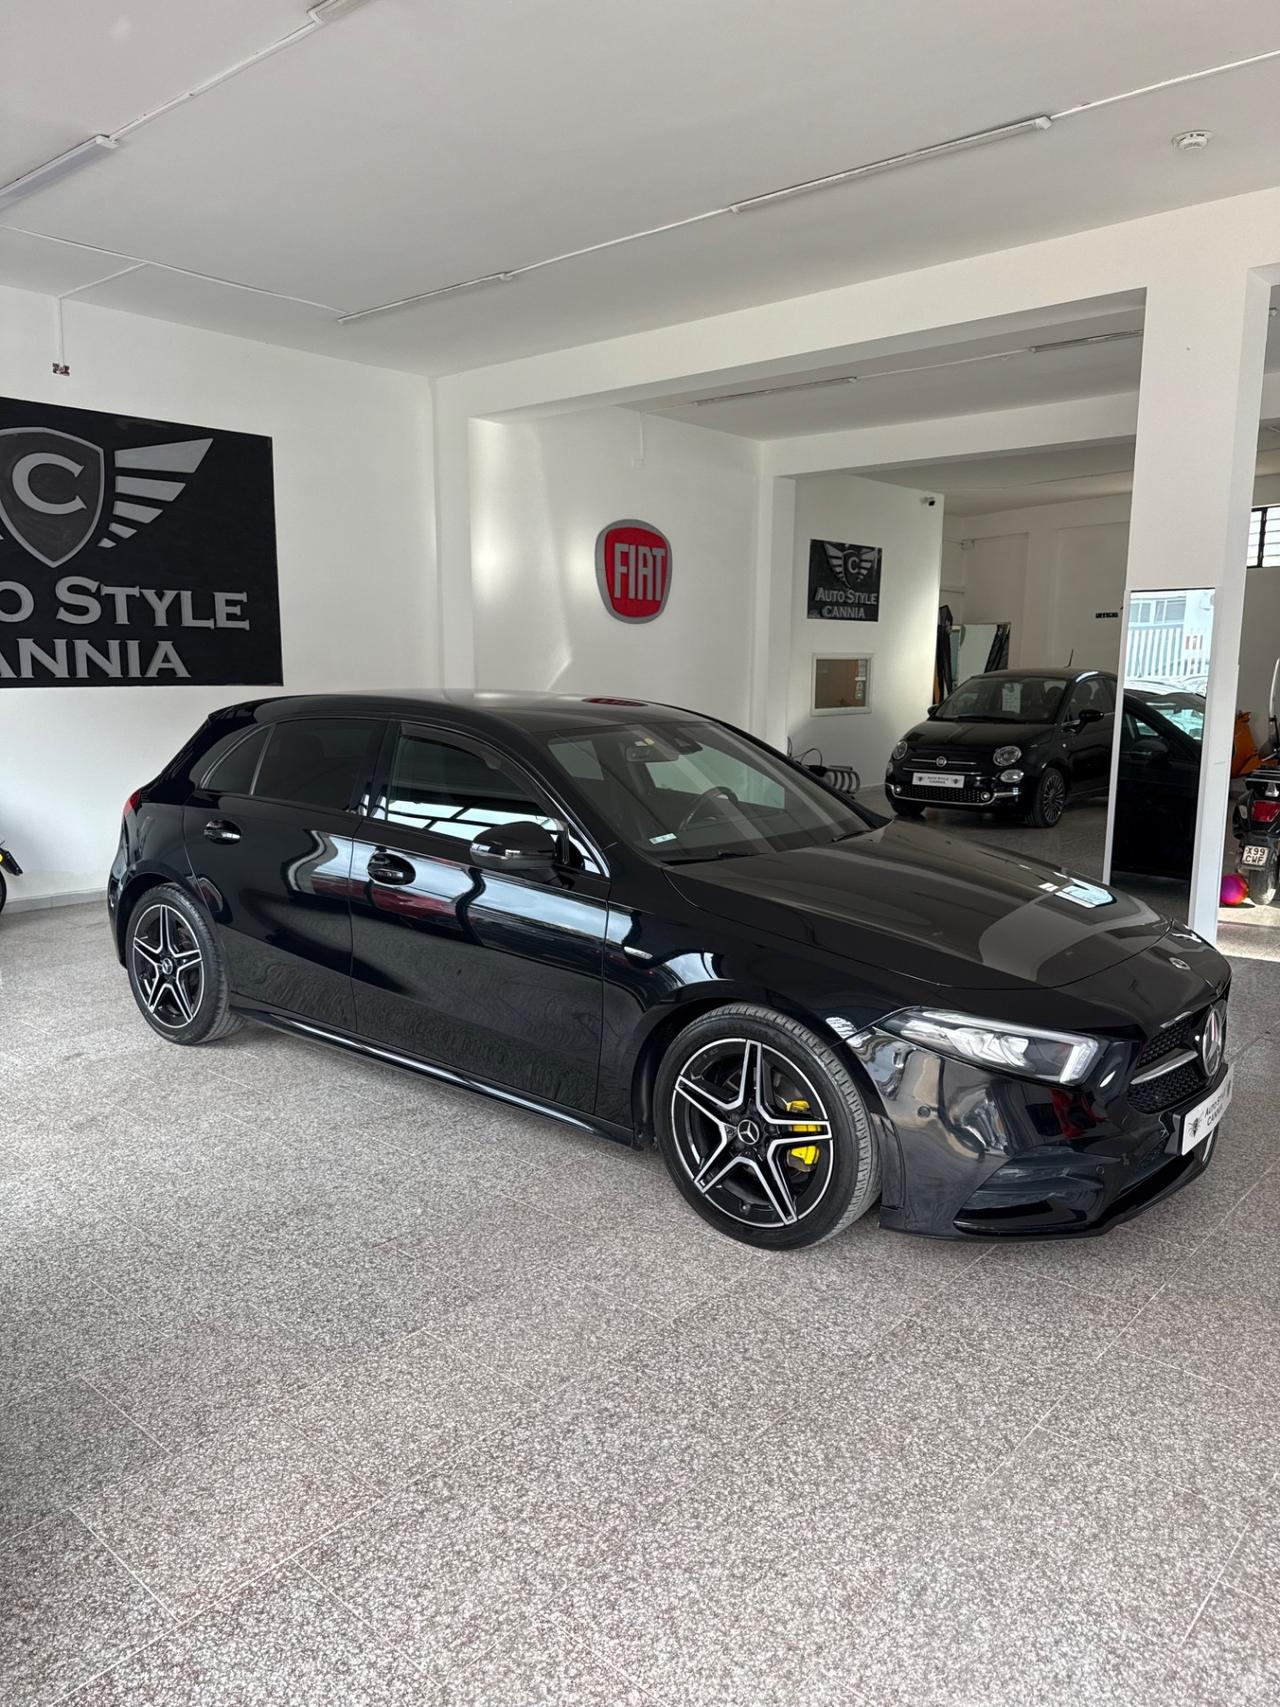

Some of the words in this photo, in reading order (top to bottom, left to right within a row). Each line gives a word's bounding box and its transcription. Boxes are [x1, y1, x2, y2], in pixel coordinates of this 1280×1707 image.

[614, 543, 665, 601] FIAT
[56, 576, 250, 631] STYLE
[822, 606, 866, 619] CANNIA
[847, 589, 877, 605] STYLE
[0, 638, 192, 679] NNIA
